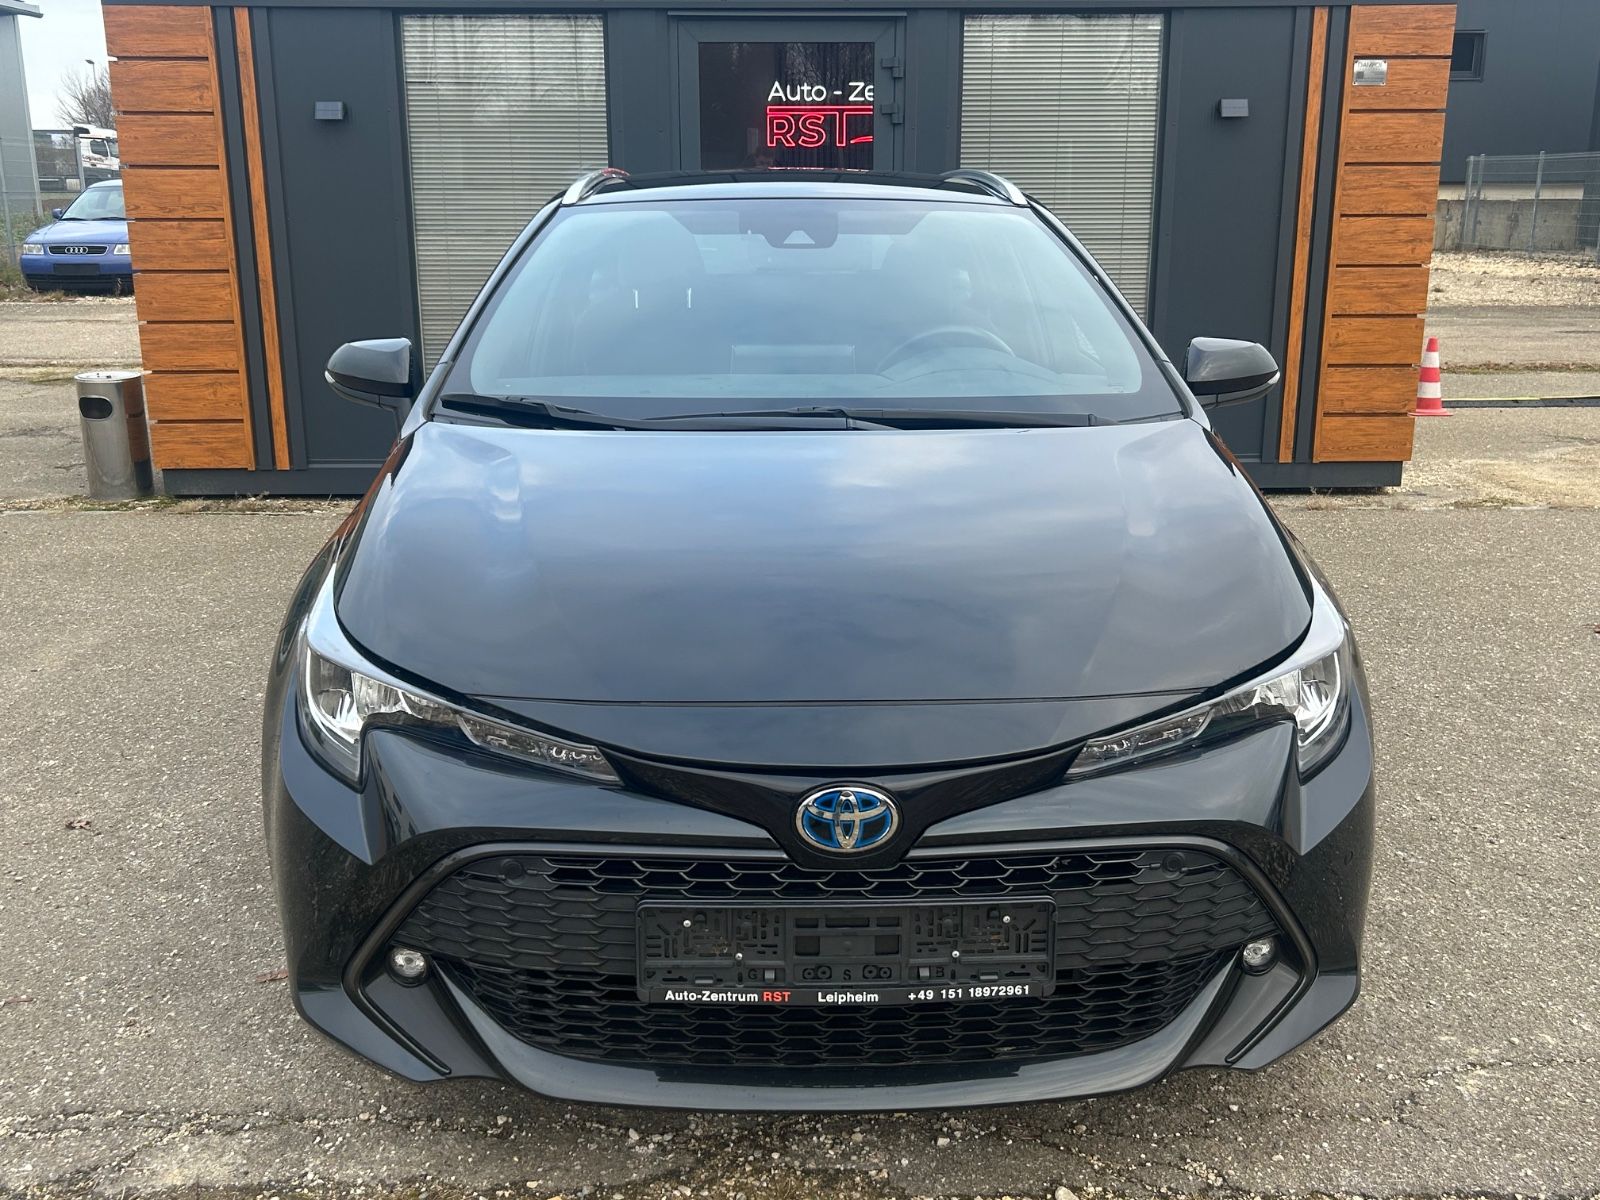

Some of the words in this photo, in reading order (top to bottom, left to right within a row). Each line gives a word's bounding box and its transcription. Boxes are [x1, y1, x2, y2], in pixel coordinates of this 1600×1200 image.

[767, 80, 827, 102] Auto
[766, 105, 847, 148] RST
[664, 989, 759, 1002] Auto-Zentrum
[762, 991, 791, 1002] RST
[817, 991, 879, 1005] Leipheim
[907, 989, 934, 1001] +49
[940, 988, 963, 999] 151
[968, 984, 1030, 998] 18972961
